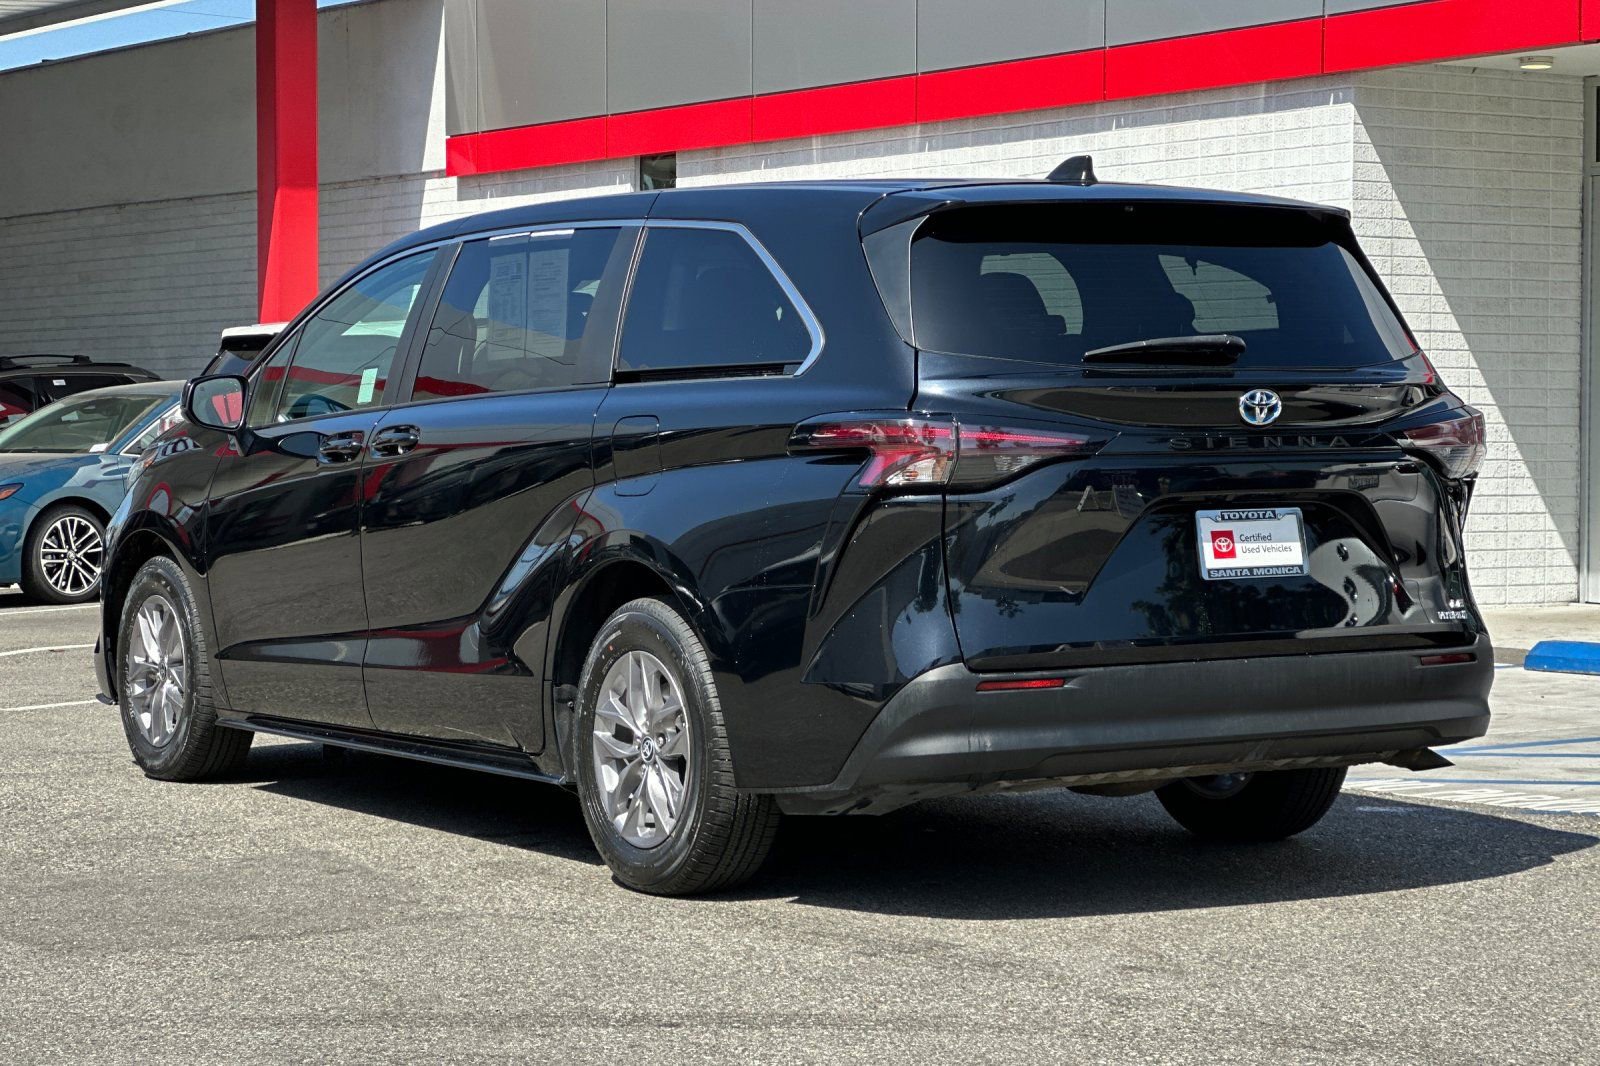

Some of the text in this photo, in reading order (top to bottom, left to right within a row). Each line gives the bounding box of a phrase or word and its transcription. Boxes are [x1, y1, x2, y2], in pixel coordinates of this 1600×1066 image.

[1168, 435, 1351, 449] SIENNA
[1222, 511, 1275, 520] TOYOTA
[1240, 534, 1272, 542] Certified
[1242, 545, 1293, 554] Used Vehicles
[1210, 566, 1302, 578] SANTA MONICA
